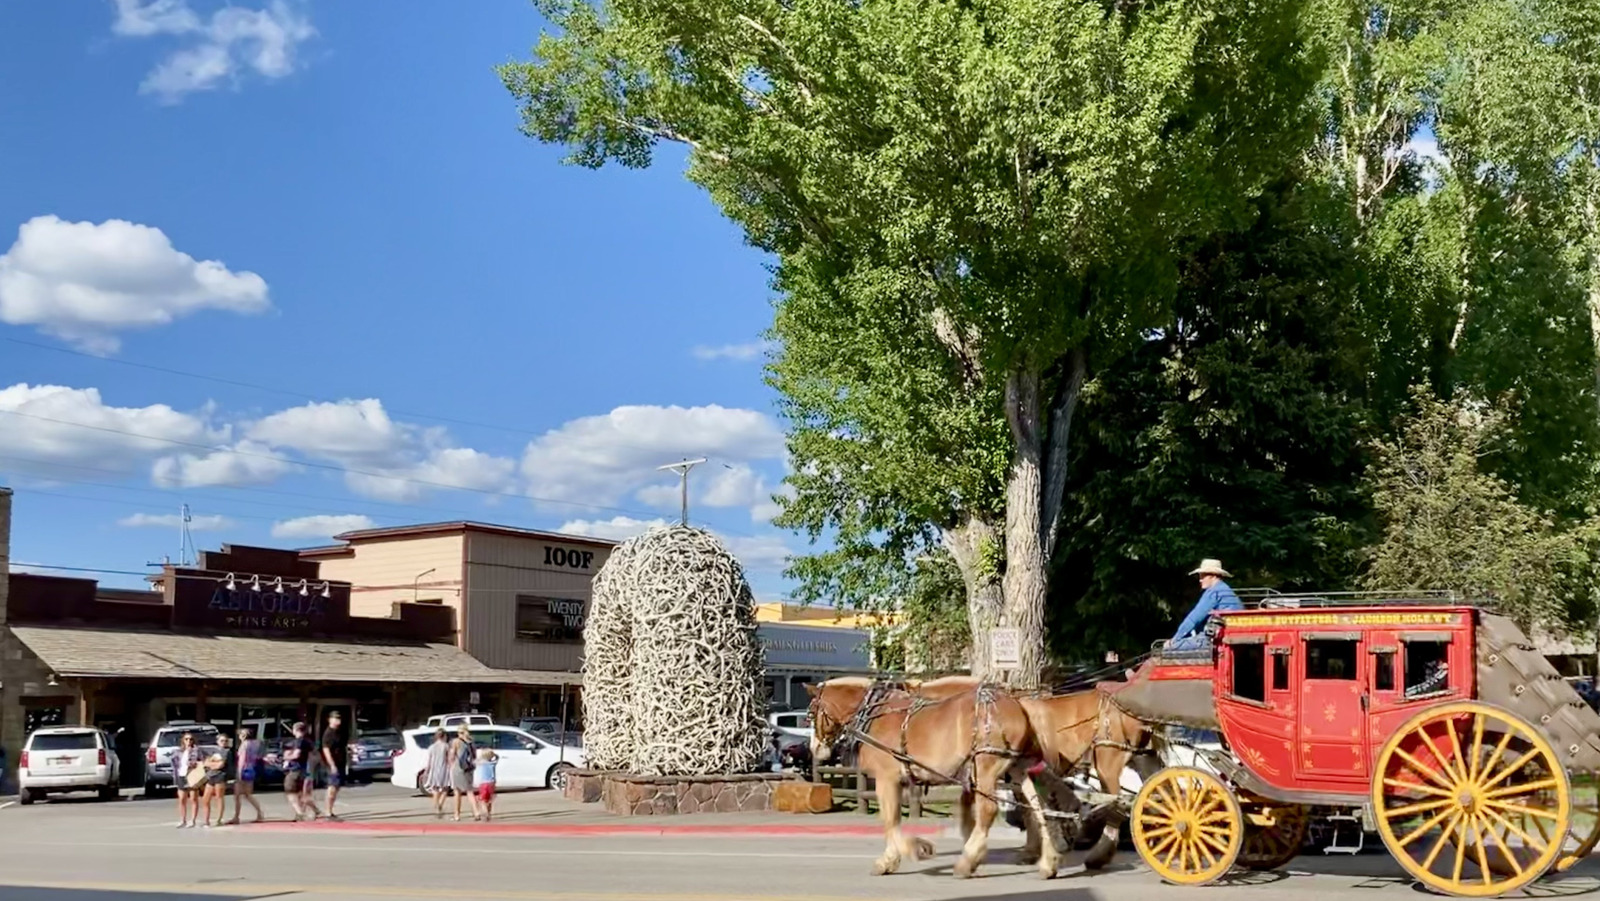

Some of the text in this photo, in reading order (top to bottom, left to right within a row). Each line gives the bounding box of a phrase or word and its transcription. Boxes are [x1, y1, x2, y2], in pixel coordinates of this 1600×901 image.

[543, 546, 594, 569] IOOF
[208, 587, 325, 615] ASTORIA
[547, 600, 584, 615] TWENTY
[238, 616, 297, 628] FINE ART
[562, 614, 584, 628] TWO
